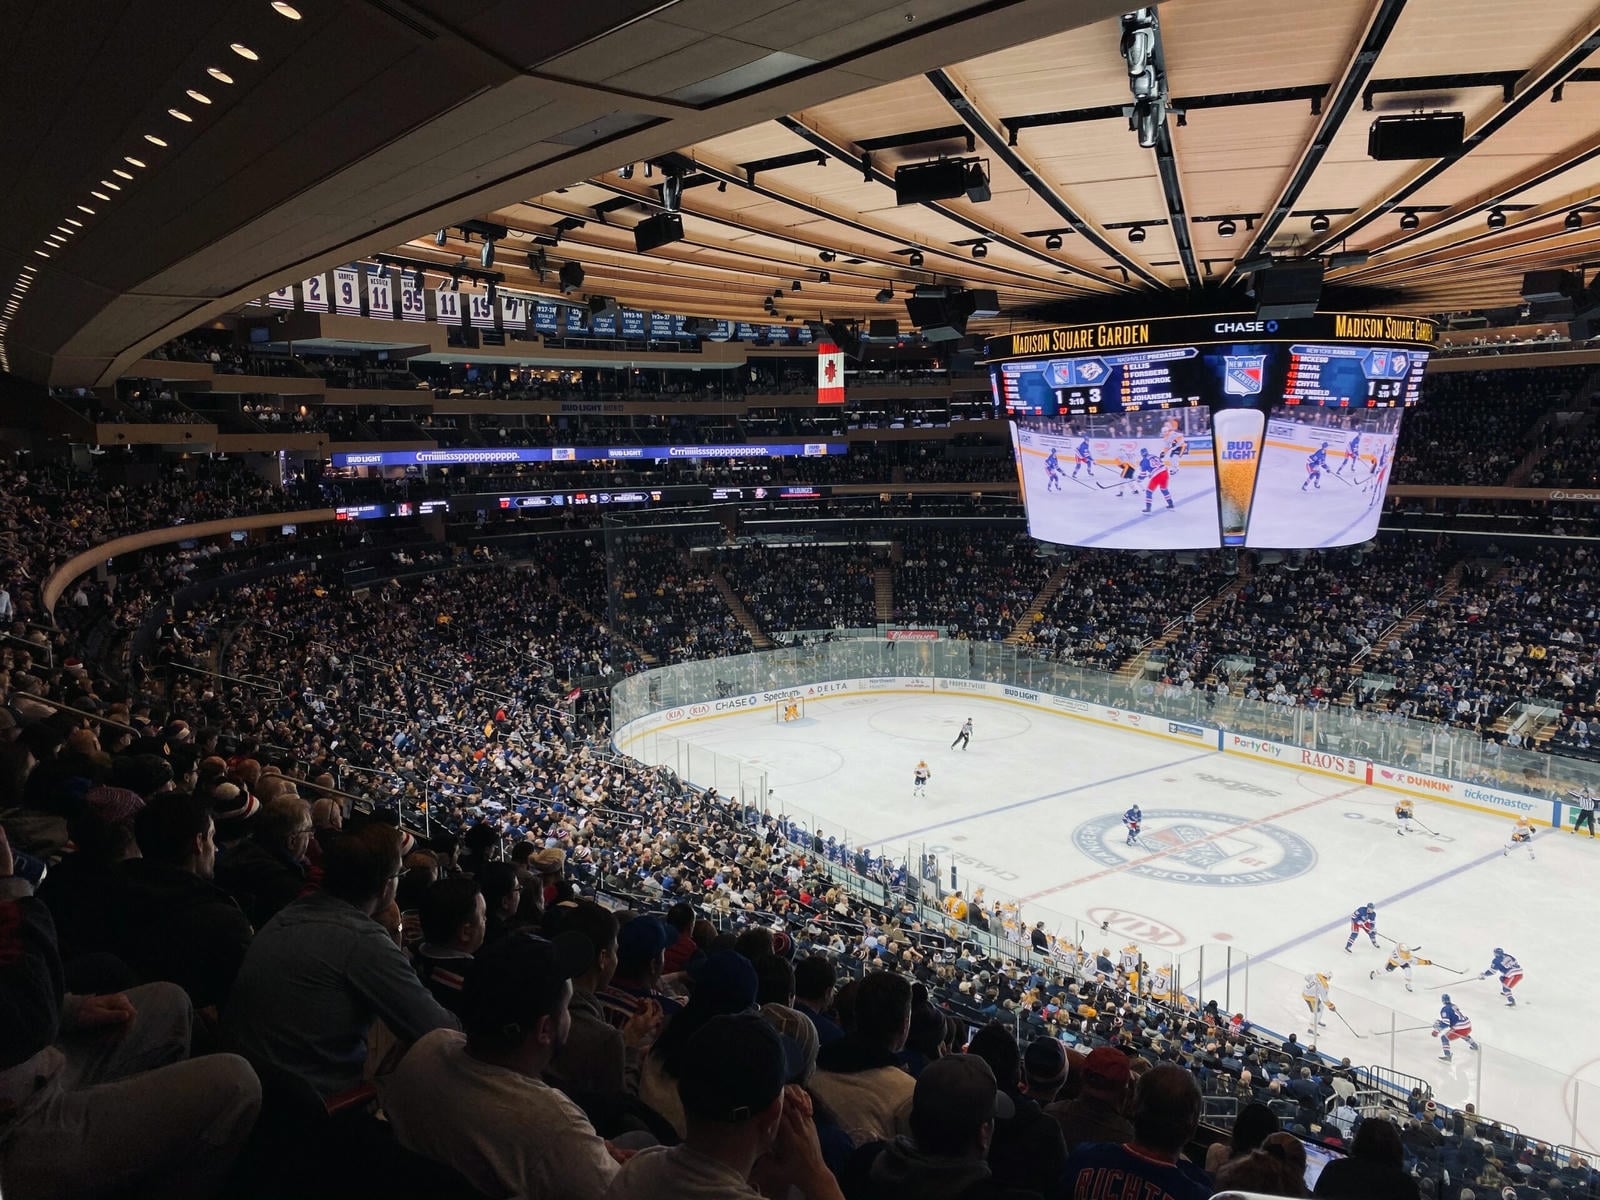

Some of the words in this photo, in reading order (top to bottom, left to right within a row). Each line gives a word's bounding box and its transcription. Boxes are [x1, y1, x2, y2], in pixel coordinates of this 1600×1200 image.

[309, 278, 320, 301] 2
[342, 282, 353, 304] 9
[373, 287, 389, 309] 11
[403, 289, 423, 312] 35
[440, 294, 457, 316] 11
[472, 297, 490, 318] 19
[506, 299, 518, 320] 7
[1215, 321, 1264, 333] CHASE
[1335, 315, 1383, 338] MADISON
[1385, 317, 1414, 340] SQUARE
[1012, 333, 1050, 355] MADISON
[1052, 329, 1094, 352] SQUARE
[1098, 324, 1149, 347] GARDEN
[1147, 351, 1186, 360] PREDATORS
[1130, 369, 1169, 378] FORSBERG
[1233, 370, 1259, 391] RANGERS
[1089, 388, 1101, 403] 3
[1132, 392, 1172, 401] JOHANSEN
[1368, 382, 1375, 396] 1
[1392, 382, 1401, 397] 3
[1055, 390, 1063, 404] 1
[1227, 441, 1253, 451] BUD
[1221, 450, 1257, 460] LIGHT
[567, 495, 573, 504] 1
[590, 495, 597, 503] 3
[817, 682, 848, 693] DELTA
[1004, 688, 1019, 697] BUD
[1019, 690, 1038, 701] LIGHT
[763, 689, 800, 702] Spectrum
[693, 705, 708, 714] KIA
[715, 698, 747, 711] CHASE
[668, 710, 683, 719] KIA
[1234, 736, 1281, 757] PartyCity
[1301, 749, 1345, 772] RAO'S
[1407, 776, 1453, 792] DUNKIN'
[1464, 788, 1533, 811] ticketmaster
[946, 852, 1019, 882] CHASE
[1137, 865, 1208, 883] YORK
[1220, 871, 1277, 885] NEW
[1107, 911, 1172, 943] KIA
[1074, 1167, 1176, 1200] RICHT
